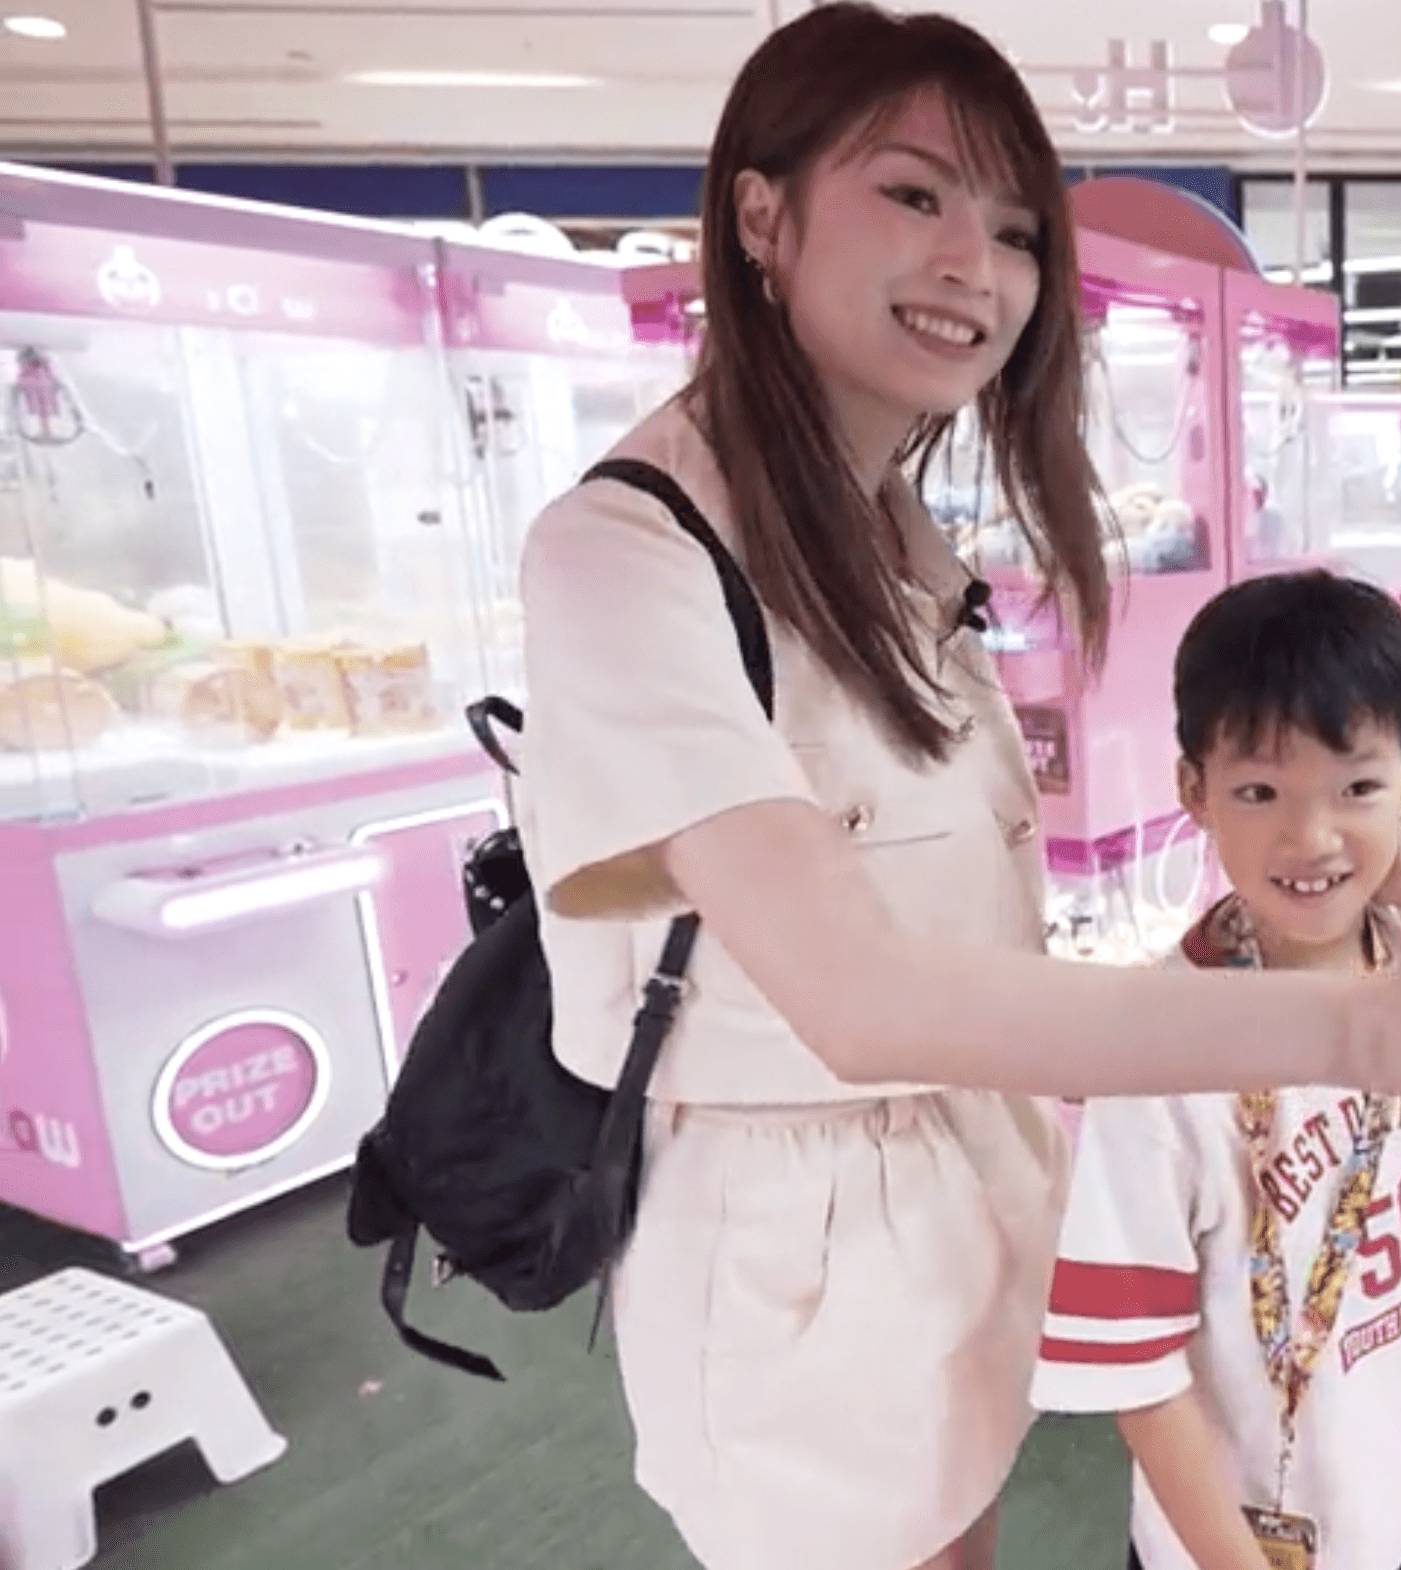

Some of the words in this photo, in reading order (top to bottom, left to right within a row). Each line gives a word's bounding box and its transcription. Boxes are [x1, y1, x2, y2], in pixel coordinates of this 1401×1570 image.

[172, 1043, 299, 1111] PRIZE
[189, 1081, 281, 1135] OUT
[1259, 1111, 1342, 1225] BEST
